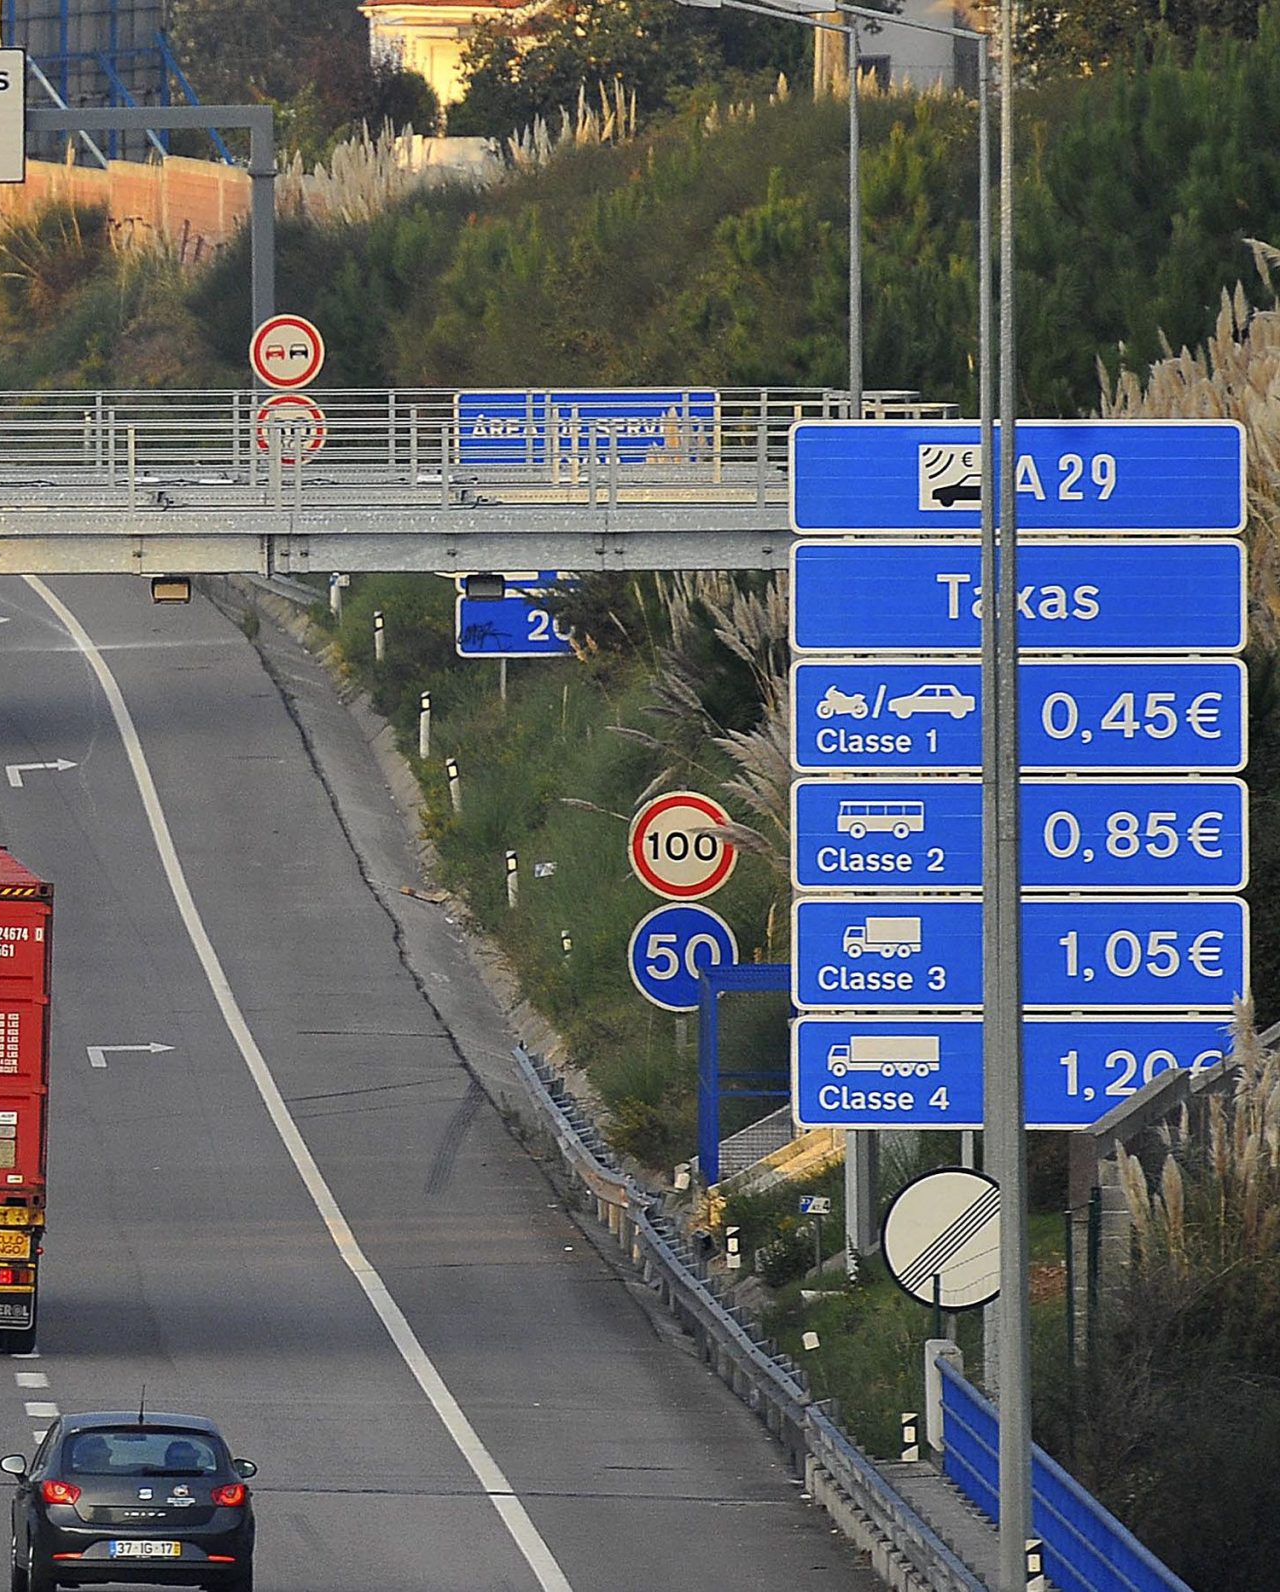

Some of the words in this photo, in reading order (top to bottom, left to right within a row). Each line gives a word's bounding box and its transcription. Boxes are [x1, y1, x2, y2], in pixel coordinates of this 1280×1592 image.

[1041, 692, 1223, 744] 0,45€
[816, 729, 912, 753] Classe
[925, 730, 938, 753] 1
[647, 831, 718, 862] 100
[1043, 811, 1224, 863] 0,85€
[816, 847, 913, 872] Classe
[926, 848, 945, 872] 2
[646, 934, 721, 980] 50
[1058, 930, 1225, 981] 1,05€
[817, 966, 913, 991] Classe
[927, 966, 946, 991] 3
[818, 1085, 914, 1110] Classe
[928, 1087, 950, 1110] 4
